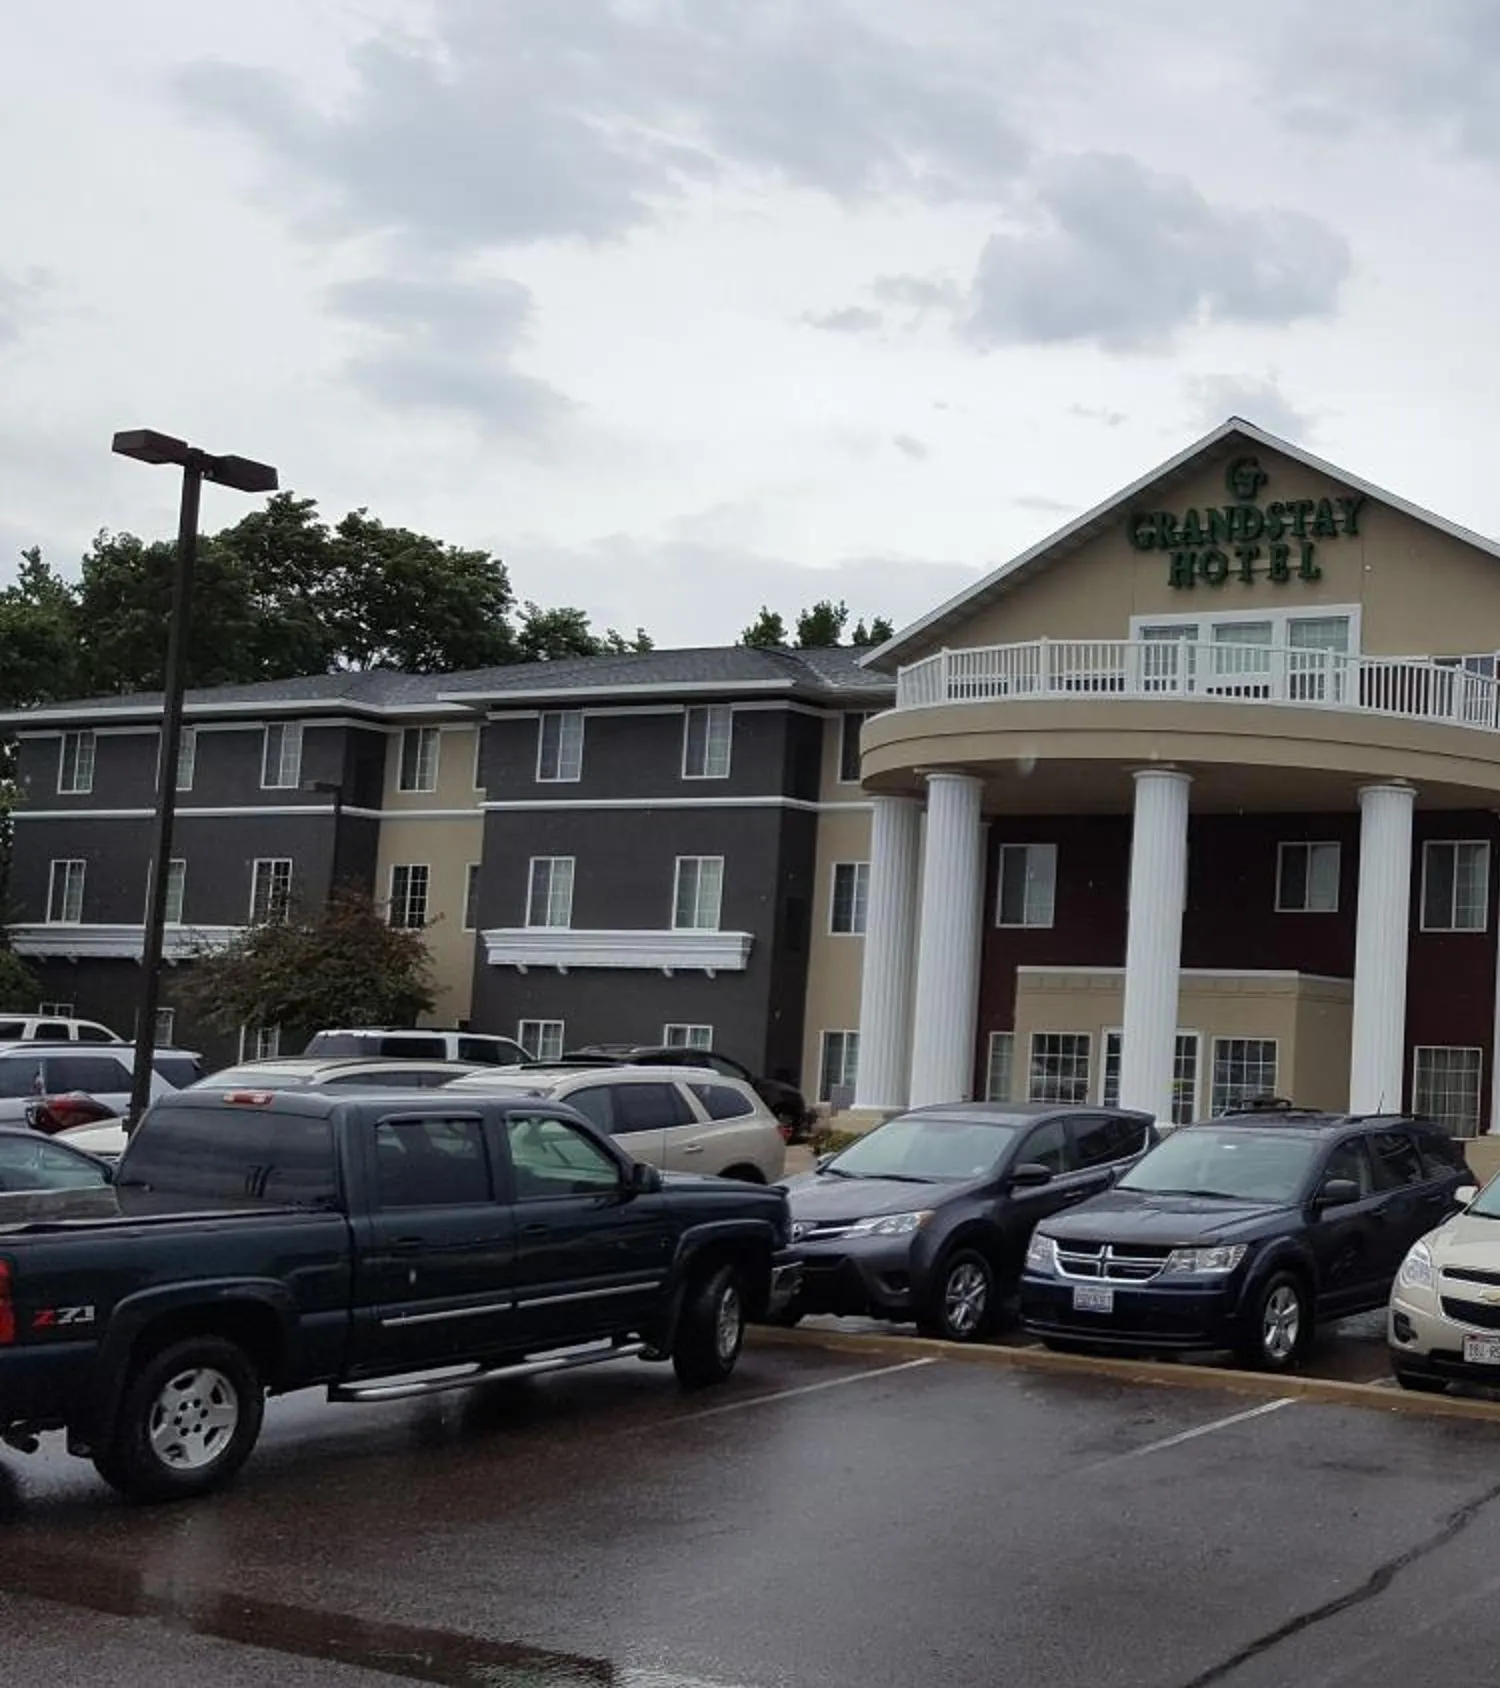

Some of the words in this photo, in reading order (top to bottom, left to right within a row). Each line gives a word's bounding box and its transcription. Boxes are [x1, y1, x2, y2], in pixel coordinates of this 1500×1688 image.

[1128, 499, 1364, 550] GRANDSTAY
[1168, 542, 1321, 588] HOTEL
[32, 1306, 95, 1325] Z71
